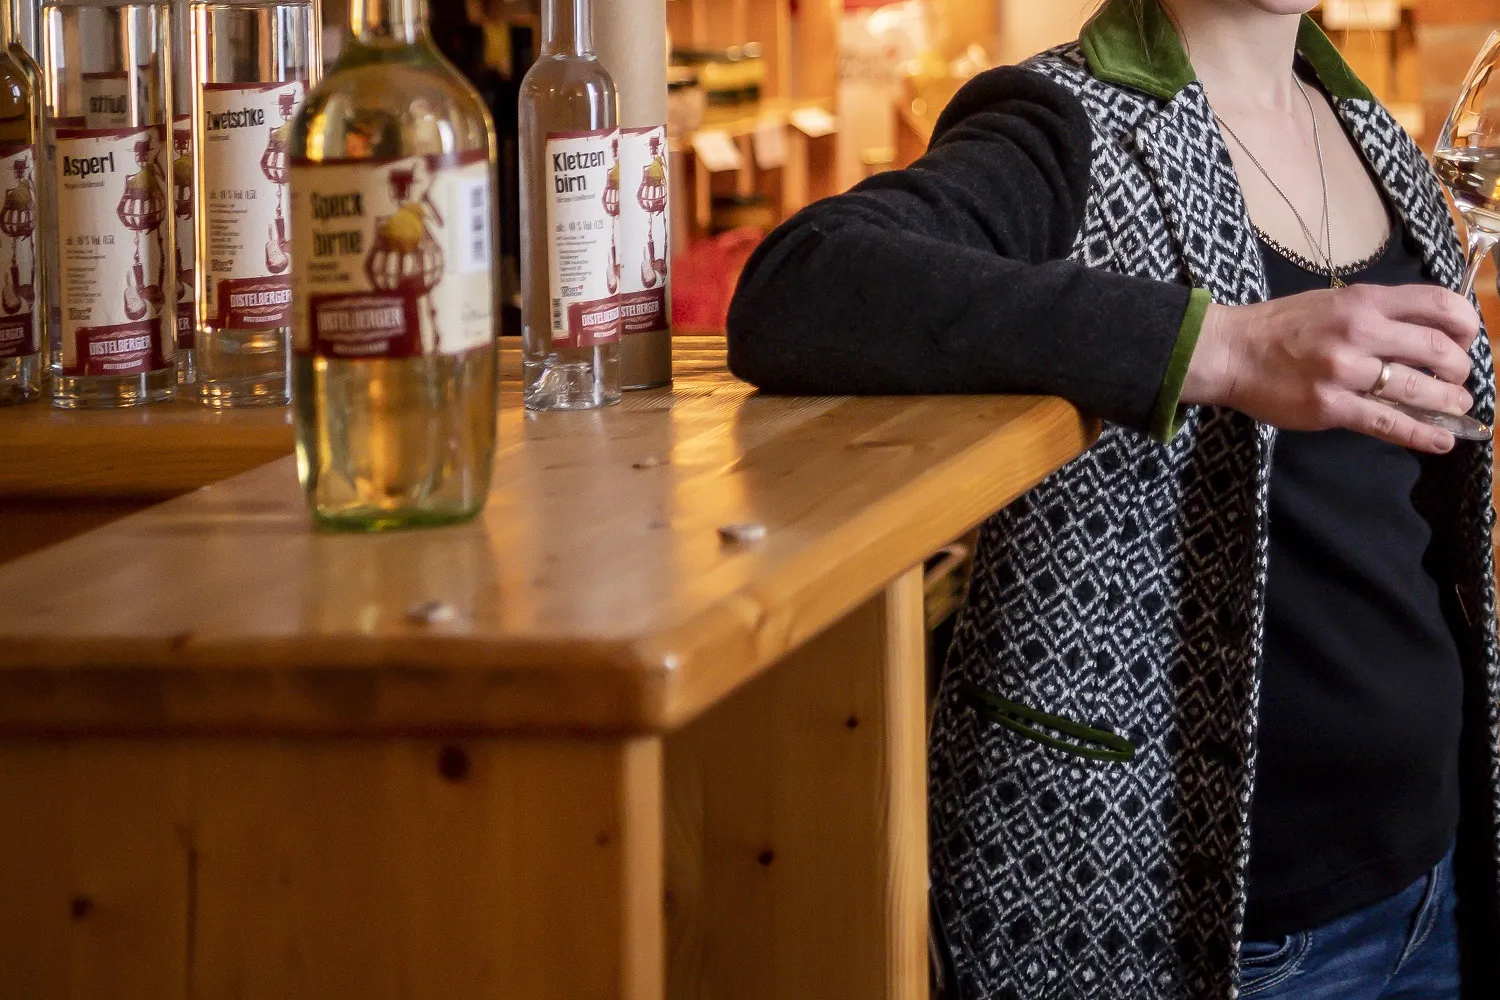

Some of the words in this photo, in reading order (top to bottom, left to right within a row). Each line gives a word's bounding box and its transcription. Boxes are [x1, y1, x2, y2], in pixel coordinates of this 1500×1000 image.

[206, 106, 265, 131] Zwetschke
[63, 151, 115, 179] Asperl
[552, 150, 606, 172] Kletzen
[555, 174, 588, 194] birn
[229, 289, 293, 308] DISTELBERGER
[620, 300, 660, 317] STELBERGER
[89, 335, 153, 356] DISTELBERGER
